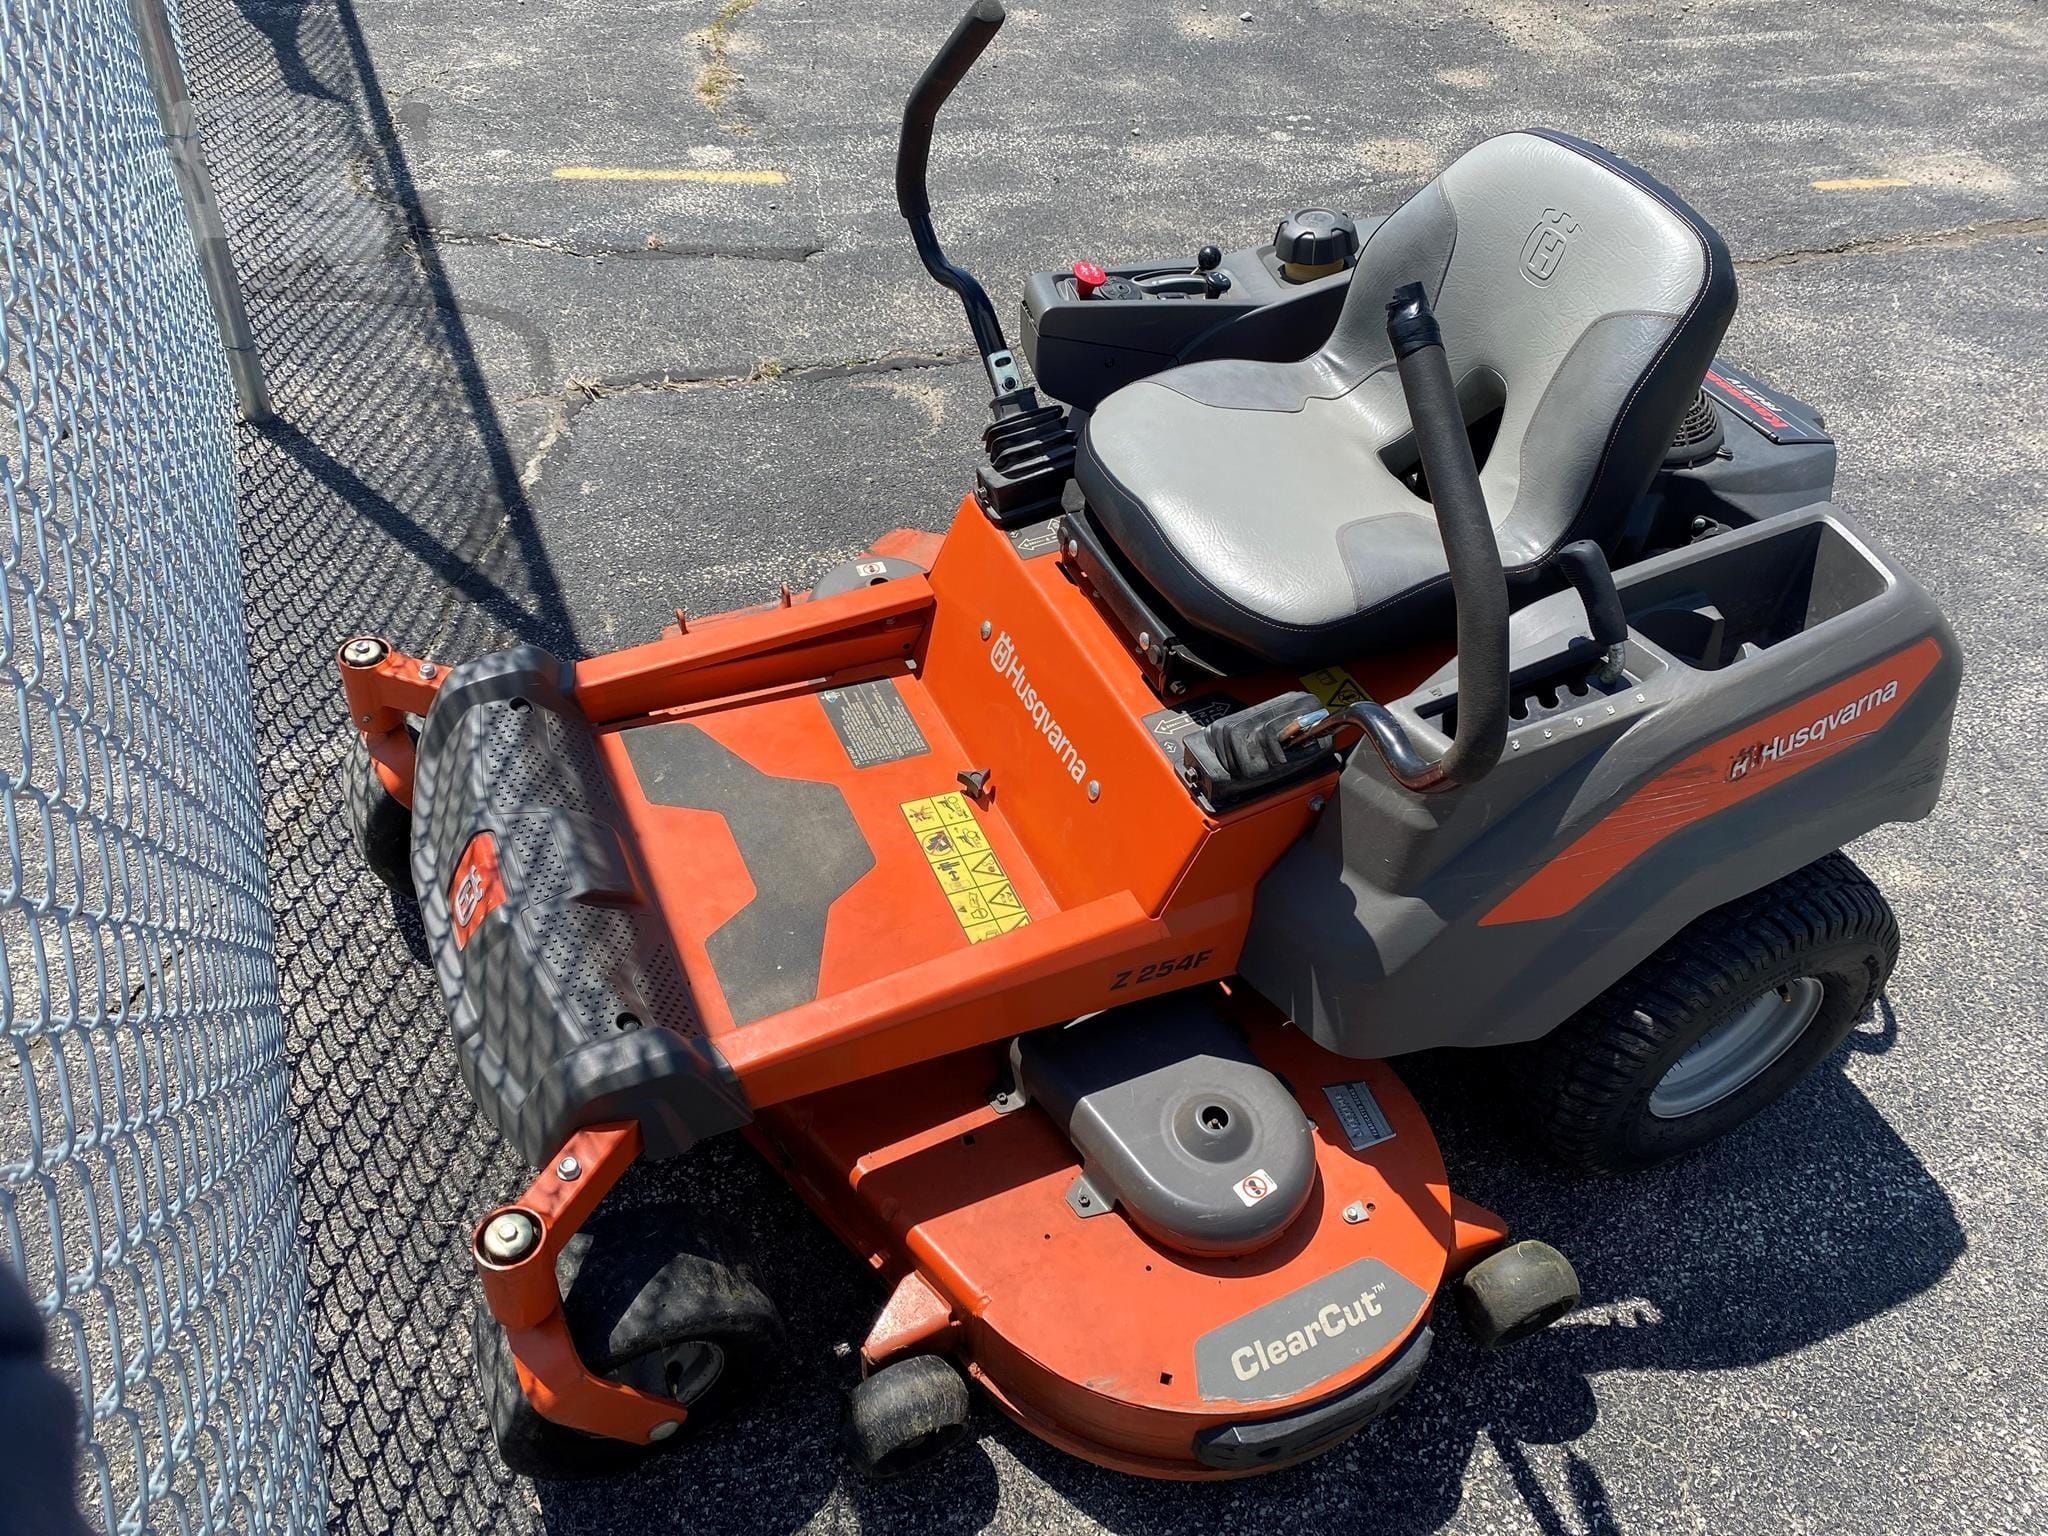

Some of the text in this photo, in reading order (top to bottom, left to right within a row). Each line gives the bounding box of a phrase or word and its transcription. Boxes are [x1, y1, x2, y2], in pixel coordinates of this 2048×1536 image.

[1005, 655, 1087, 784] Husqvarna
[1762, 680, 1899, 762] Husqvarna
[1110, 949, 1213, 991] Z 254F
